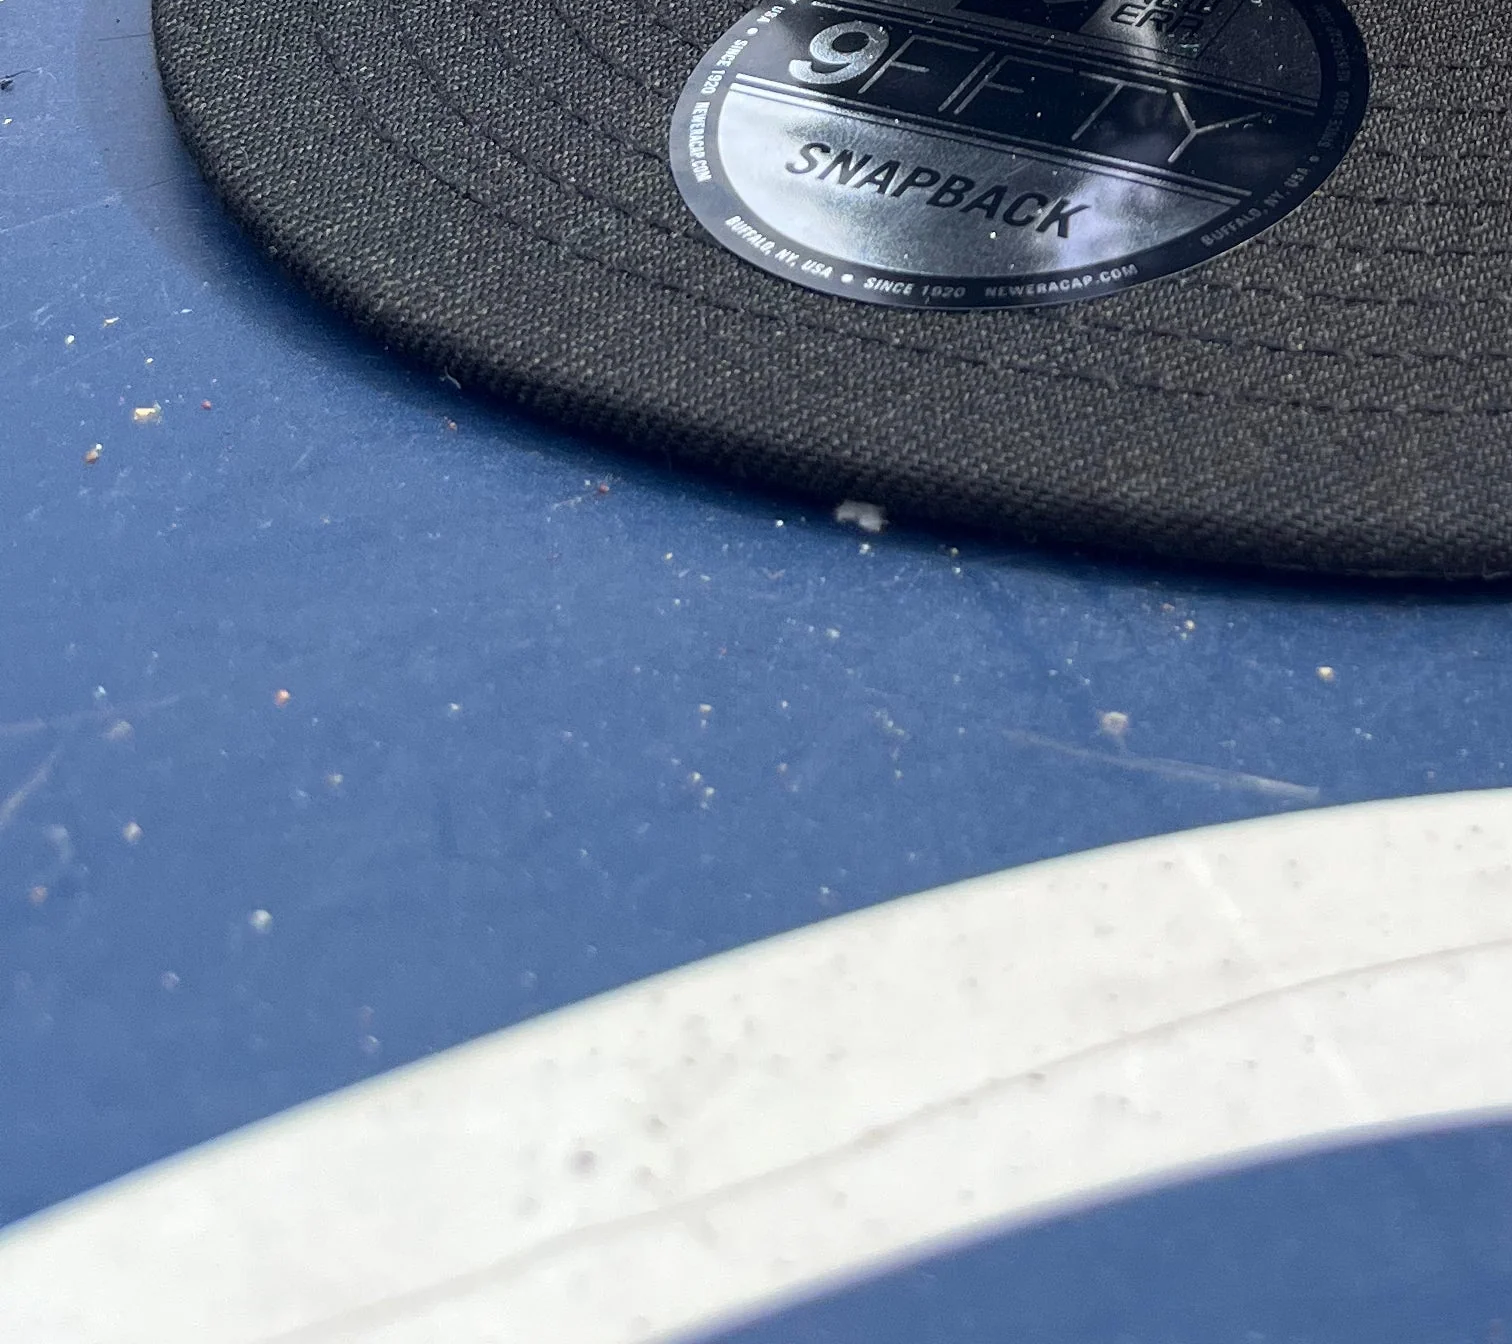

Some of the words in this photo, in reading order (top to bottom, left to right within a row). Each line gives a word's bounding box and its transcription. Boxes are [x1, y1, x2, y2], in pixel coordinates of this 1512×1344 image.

[756, 5, 786, 24] USA
[716, 39, 749, 68] SINCE
[701, 69, 726, 95] 1920
[688, 101, 712, 184] NEWERACAP.COM
[785, 142, 1089, 239] SNAPBACK
[1284, 167, 1310, 188] USA
[801, 259, 834, 279] USA
[863, 276, 915, 296] SINCE
[921, 284, 967, 299] 1920
[984, 263, 1139, 298] NEWERACAP.COM
